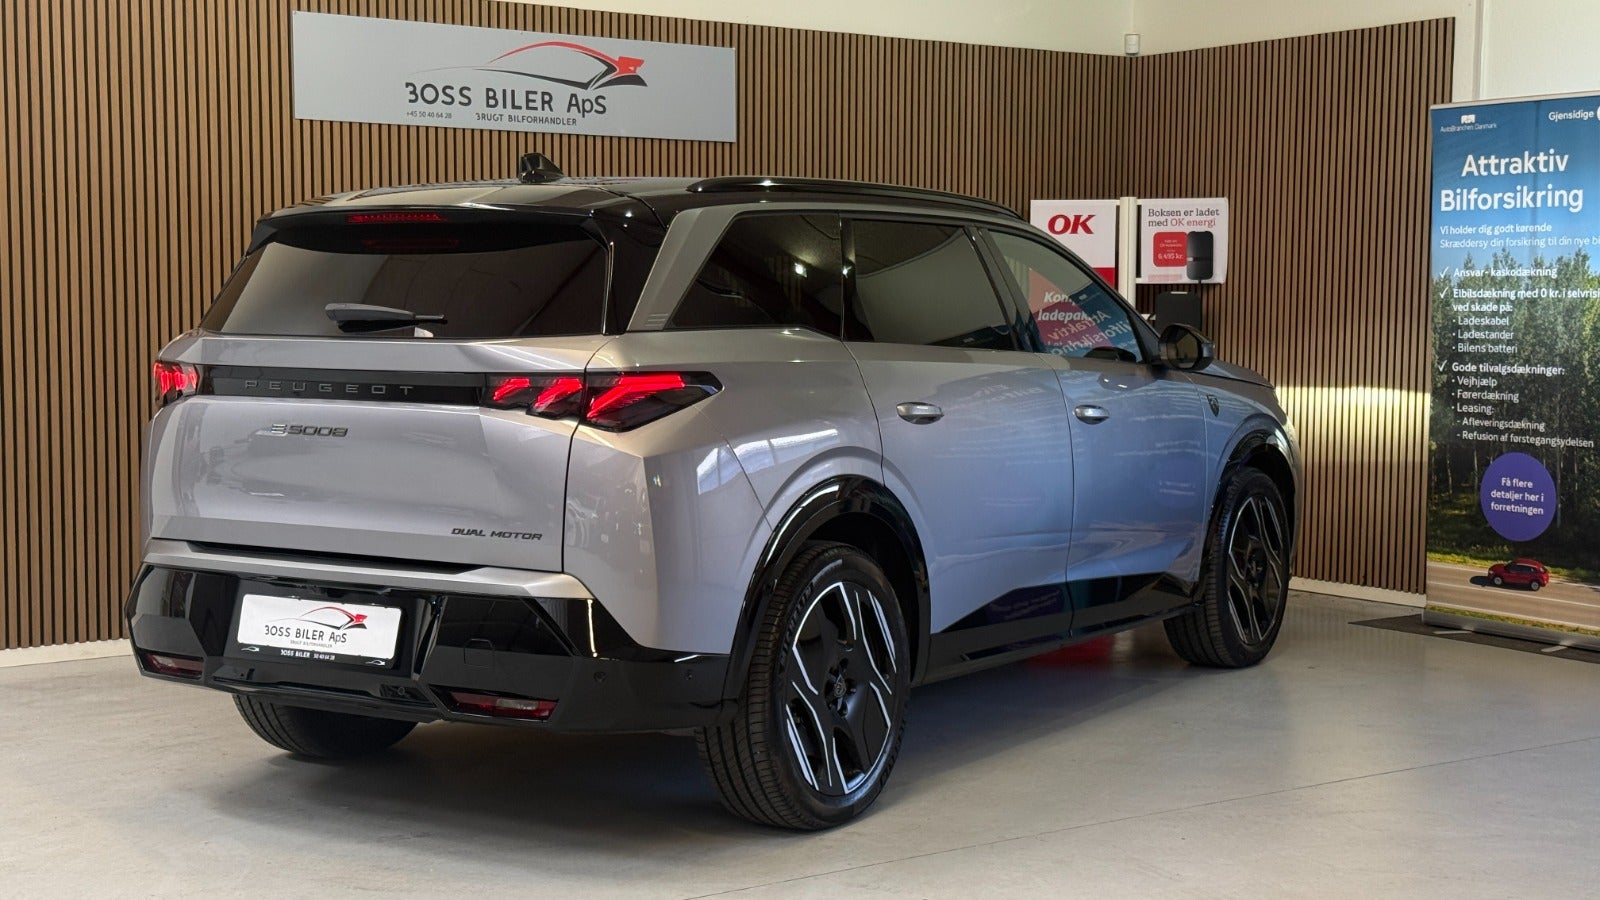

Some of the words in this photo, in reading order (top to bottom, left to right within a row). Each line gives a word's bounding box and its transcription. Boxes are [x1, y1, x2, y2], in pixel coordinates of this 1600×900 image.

[485, 87, 554, 112] BILER
[566, 93, 607, 118] ApS
[508, 115, 577, 126] BILFORHANDLER
[1548, 109, 1595, 122] Gjensidige
[1461, 148, 1569, 177] Attraktiv
[1440, 183, 1584, 213] Bilforsikring
[1148, 208, 1181, 217] Boksen
[1183, 209, 1194, 217] er
[1196, 208, 1220, 217] ladet
[1047, 214, 1096, 235] OK
[1148, 218, 1168, 227] med
[1170, 218, 1185, 227] OK
[1187, 218, 1216, 229] energi
[1440, 226, 1449, 235] Vi
[1450, 225, 1477, 235] holder
[1478, 224, 1493, 236] dig
[1494, 224, 1514, 236] godt
[1515, 223, 1552, 233] kørende
[1440, 237, 1488, 249] Skræddersy
[1490, 236, 1505, 247] din
[1506, 235, 1546, 248] forsikring
[1548, 236, 1557, 246] til
[1559, 235, 1572, 246] din
[1574, 237, 1590, 247] nye
[1453, 267, 1489, 277] Ansvar-
[1490, 267, 1558, 279] kaskodækning
[1453, 288, 1516, 300] Elbilsdækning
[1517, 289, 1539, 298] med
[1540, 288, 1548, 298] 0
[1549, 288, 1561, 298] kr.
[1452, 302, 1470, 312] ved
[1470, 302, 1498, 312] skade
[1499, 302, 1514, 314] på:
[1457, 316, 1510, 326] Ladeskabel
[1457, 329, 1514, 340] Ladestander
[1457, 342, 1486, 353] Bilens
[1488, 343, 1518, 354] batteri
[1451, 362, 1477, 372] Gode
[1478, 363, 1566, 376] tilvalgsdækninger:
[244, 380, 413, 396] PEUGEOT
[1456, 375, 1498, 388] Vejhjælp
[1457, 389, 1519, 403] Førerdækning
[1456, 402, 1495, 416] Leasing:
[1462, 416, 1546, 432] Afleveringsdækning
[1462, 430, 1499, 442] Refusion
[1499, 433, 1509, 443] af
[1510, 433, 1595, 448] førstegangsydelsen
[1501, 477, 1511, 488] Få
[1512, 478, 1533, 488] flere
[1490, 490, 1523, 502] detaljer
[1524, 492, 1539, 502] her
[1490, 502, 1544, 516] forretningen
[451, 527, 486, 537] DUAL
[490, 530, 543, 541] MOTOR
[295, 627, 325, 640] BILER
[328, 631, 347, 645] ApS
